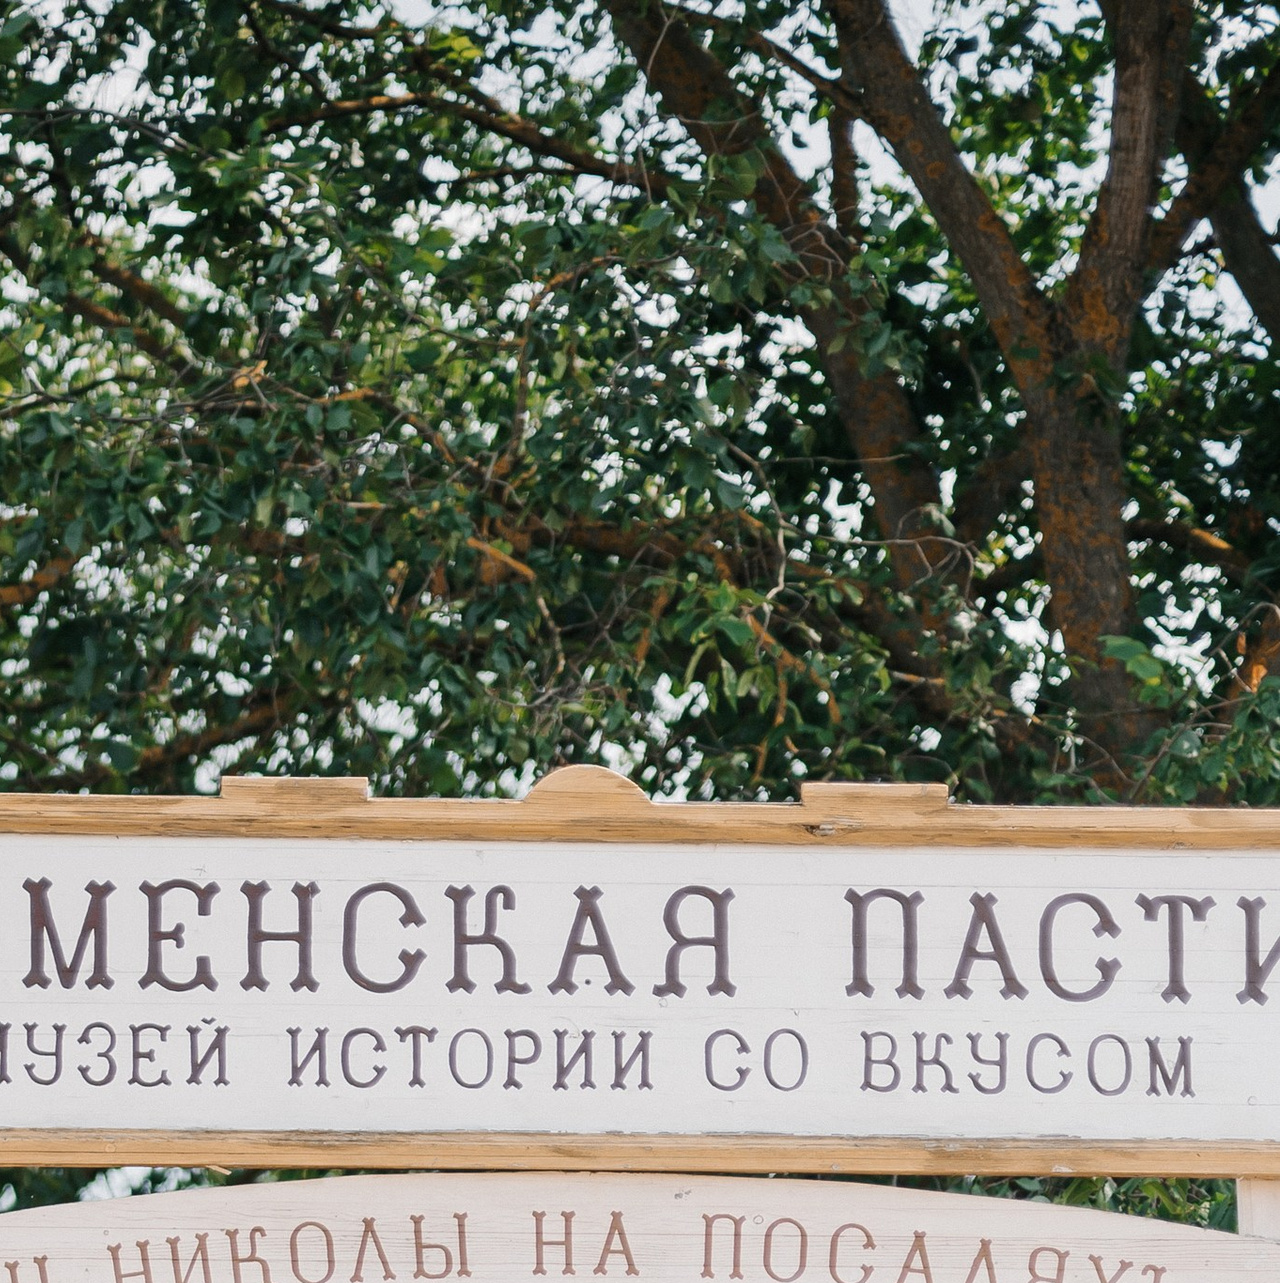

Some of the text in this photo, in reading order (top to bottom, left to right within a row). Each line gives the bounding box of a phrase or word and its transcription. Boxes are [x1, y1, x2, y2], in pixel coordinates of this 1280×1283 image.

[286, 1025, 653, 1091] ИСТОРИИ
[704, 1028, 809, 1092] СО
[859, 1030, 1196, 1098] ВКУСОМ
[531, 1210, 640, 1277] НА
